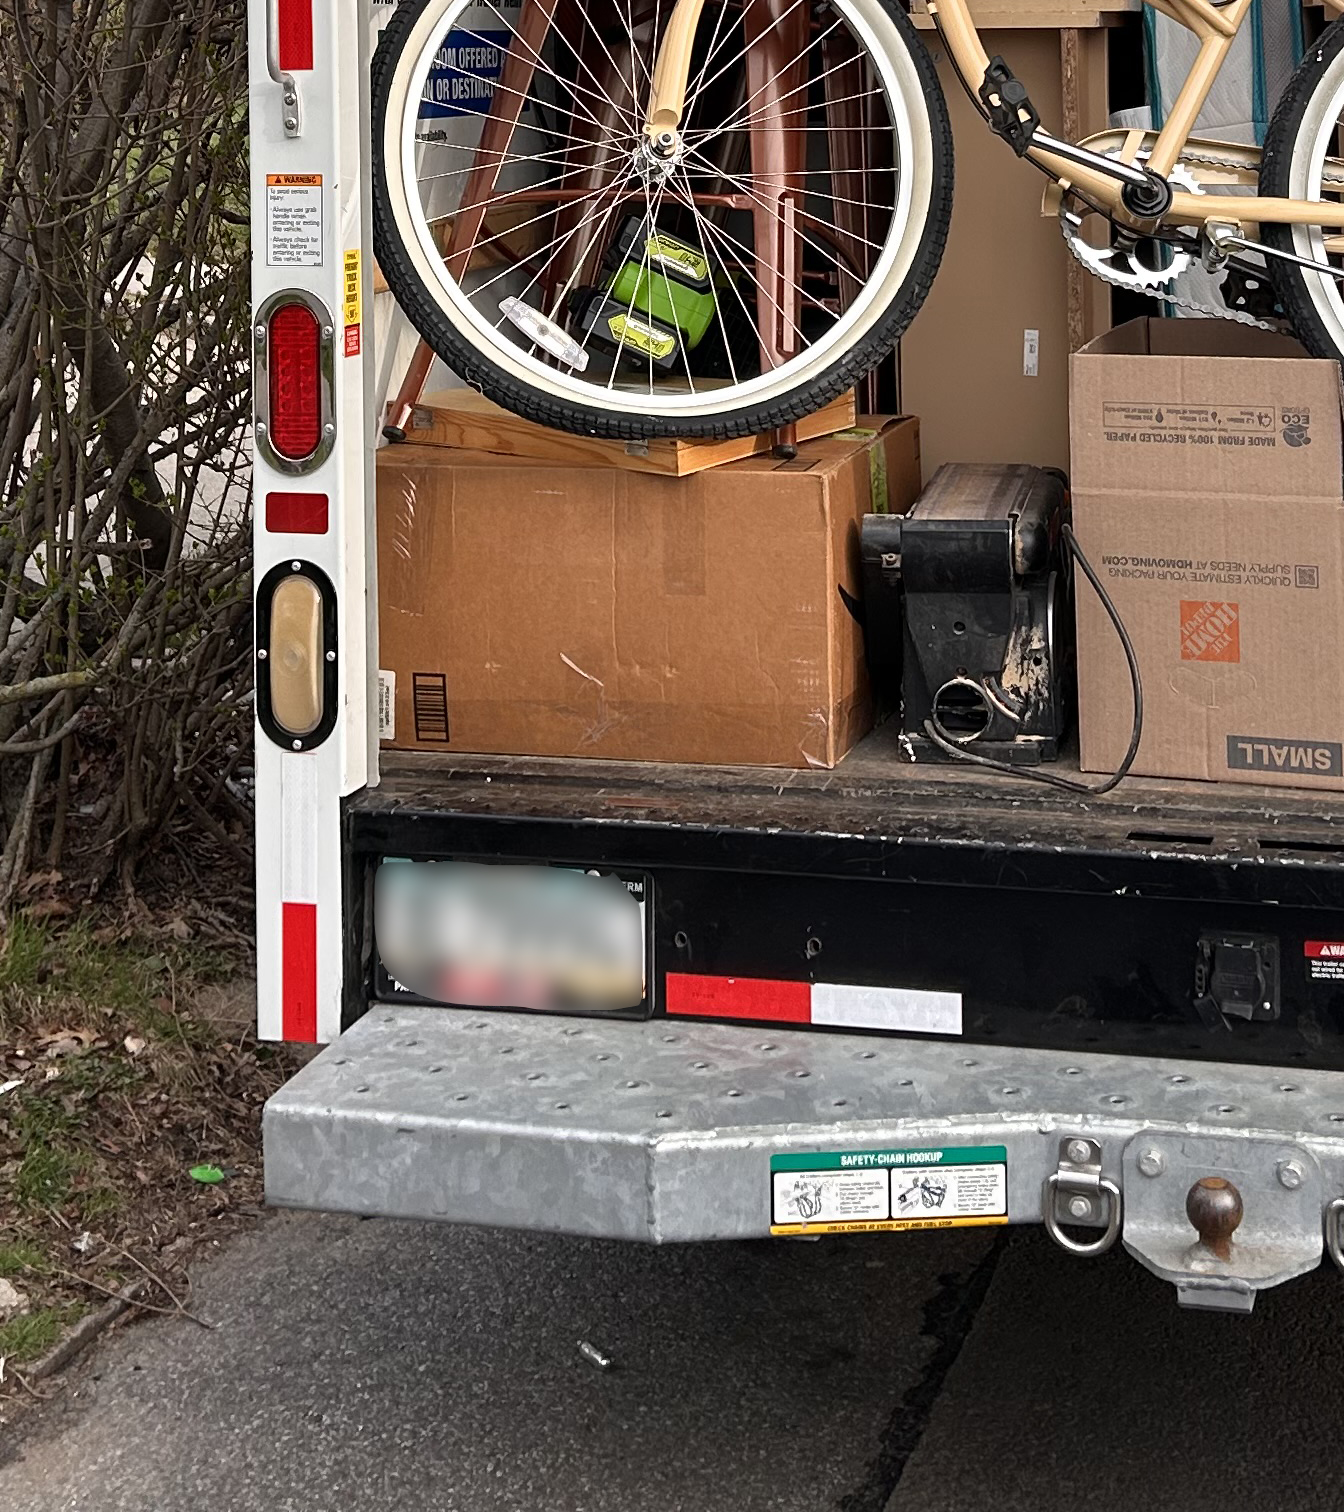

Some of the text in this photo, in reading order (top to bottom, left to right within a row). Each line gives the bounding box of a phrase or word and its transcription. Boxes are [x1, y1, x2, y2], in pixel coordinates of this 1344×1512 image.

[458, 46, 498, 69] OFFERED
[436, 78, 450, 100] OR
[1281, 414, 1310, 425] ECO
[1104, 431, 1276, 446] MADE FROM 100% RECYCLED PAPER.
[1194, 560, 1207, 570] AT
[1210, 561, 1246, 572] NEEDS
[1249, 563, 1291, 575] SUPPLY
[1108, 567, 1291, 587] QUICKLY ESTIMATE YOUR PACKING
[1181, 601, 1215, 636] DEPOT
[1181, 602, 1238, 657] HOME
[1209, 632, 1232, 656] THE
[1238, 742, 1332, 770] SMALL
[840, 1151, 943, 1166] SAFETY-CHAIN HOOKUP
